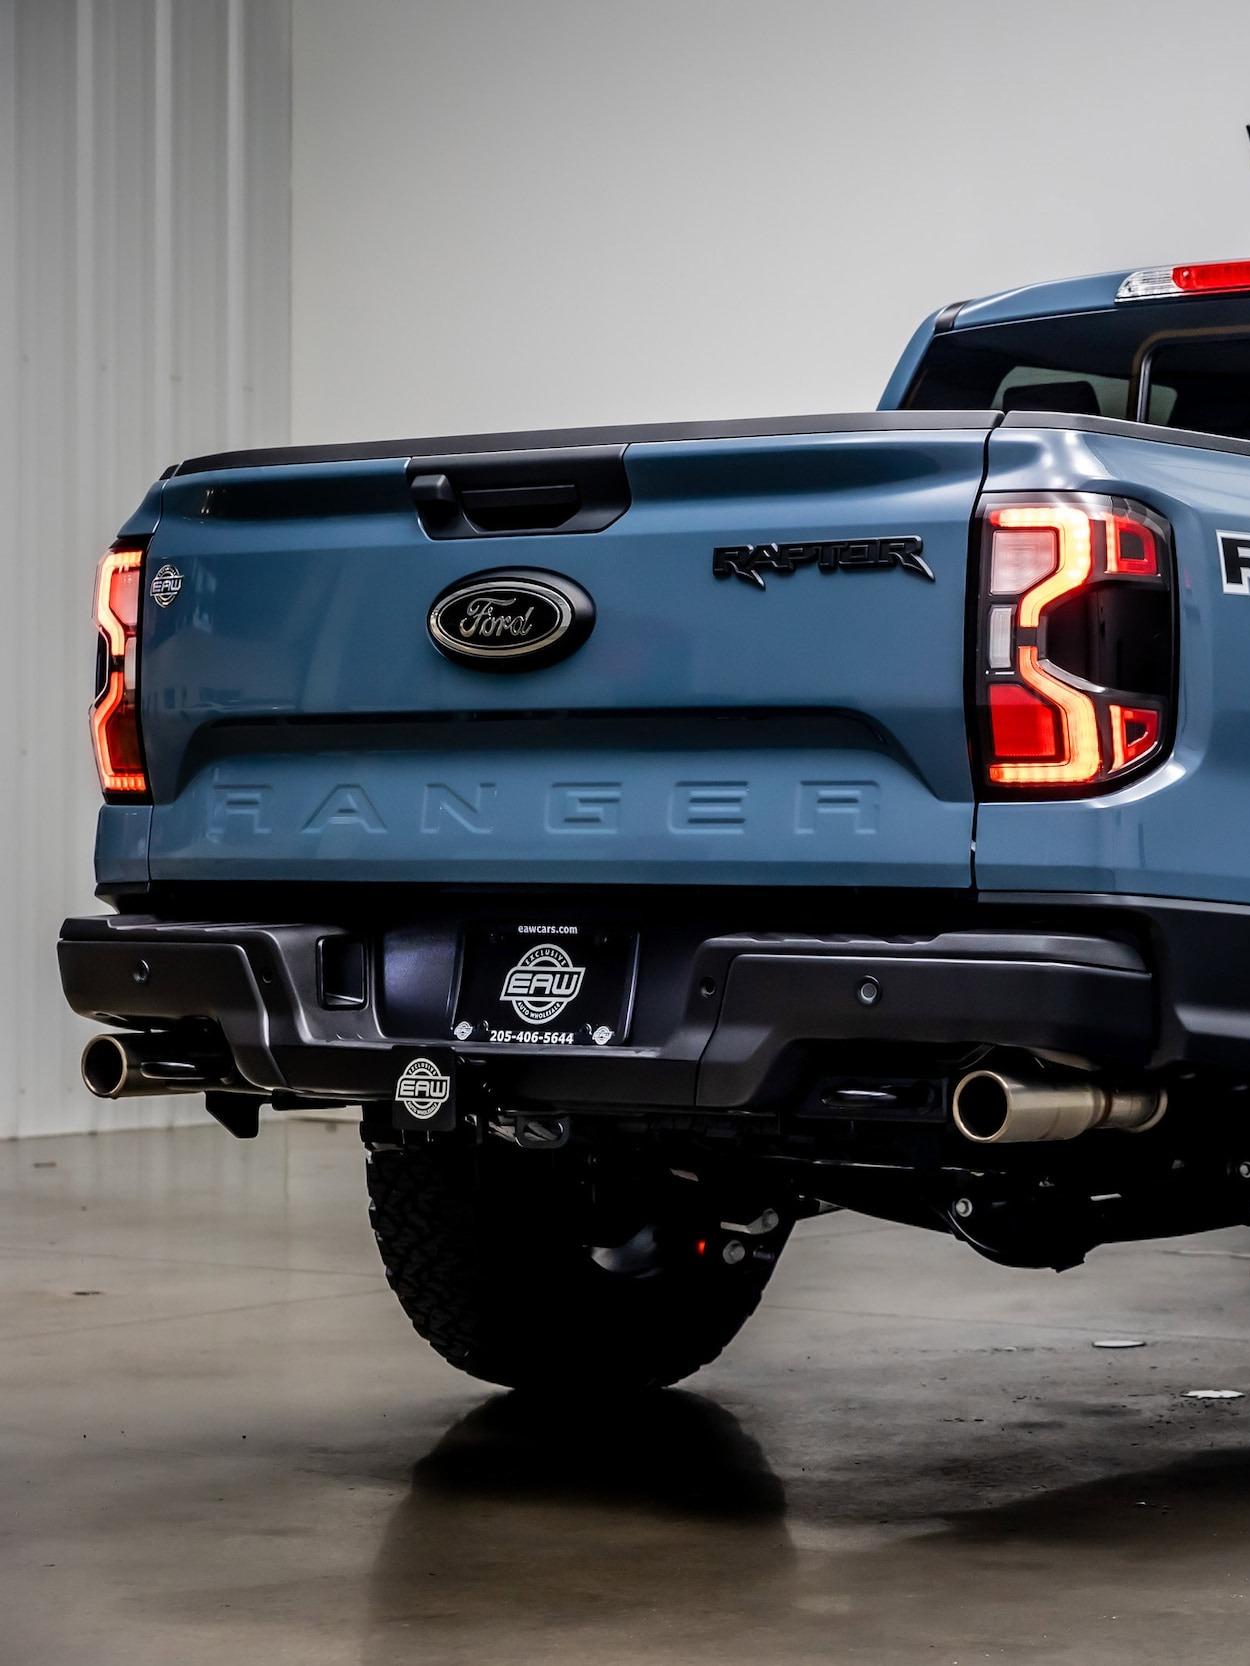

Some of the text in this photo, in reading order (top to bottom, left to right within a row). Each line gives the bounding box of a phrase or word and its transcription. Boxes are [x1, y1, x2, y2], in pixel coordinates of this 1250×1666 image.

[713, 535, 936, 591] RAPTOR
[152, 579, 181, 592] EAW
[459, 597, 534, 638] Ford
[206, 780, 881, 835] RANGER
[518, 925, 578, 934] eawcars.com
[525, 949, 566, 966] EXCLUSIVE
[507, 973, 578, 995] EAW
[517, 1001, 530, 1016] AUTO
[490, 1030, 574, 1044] 205-406-5644
[400, 1080, 446, 1097] EAW
